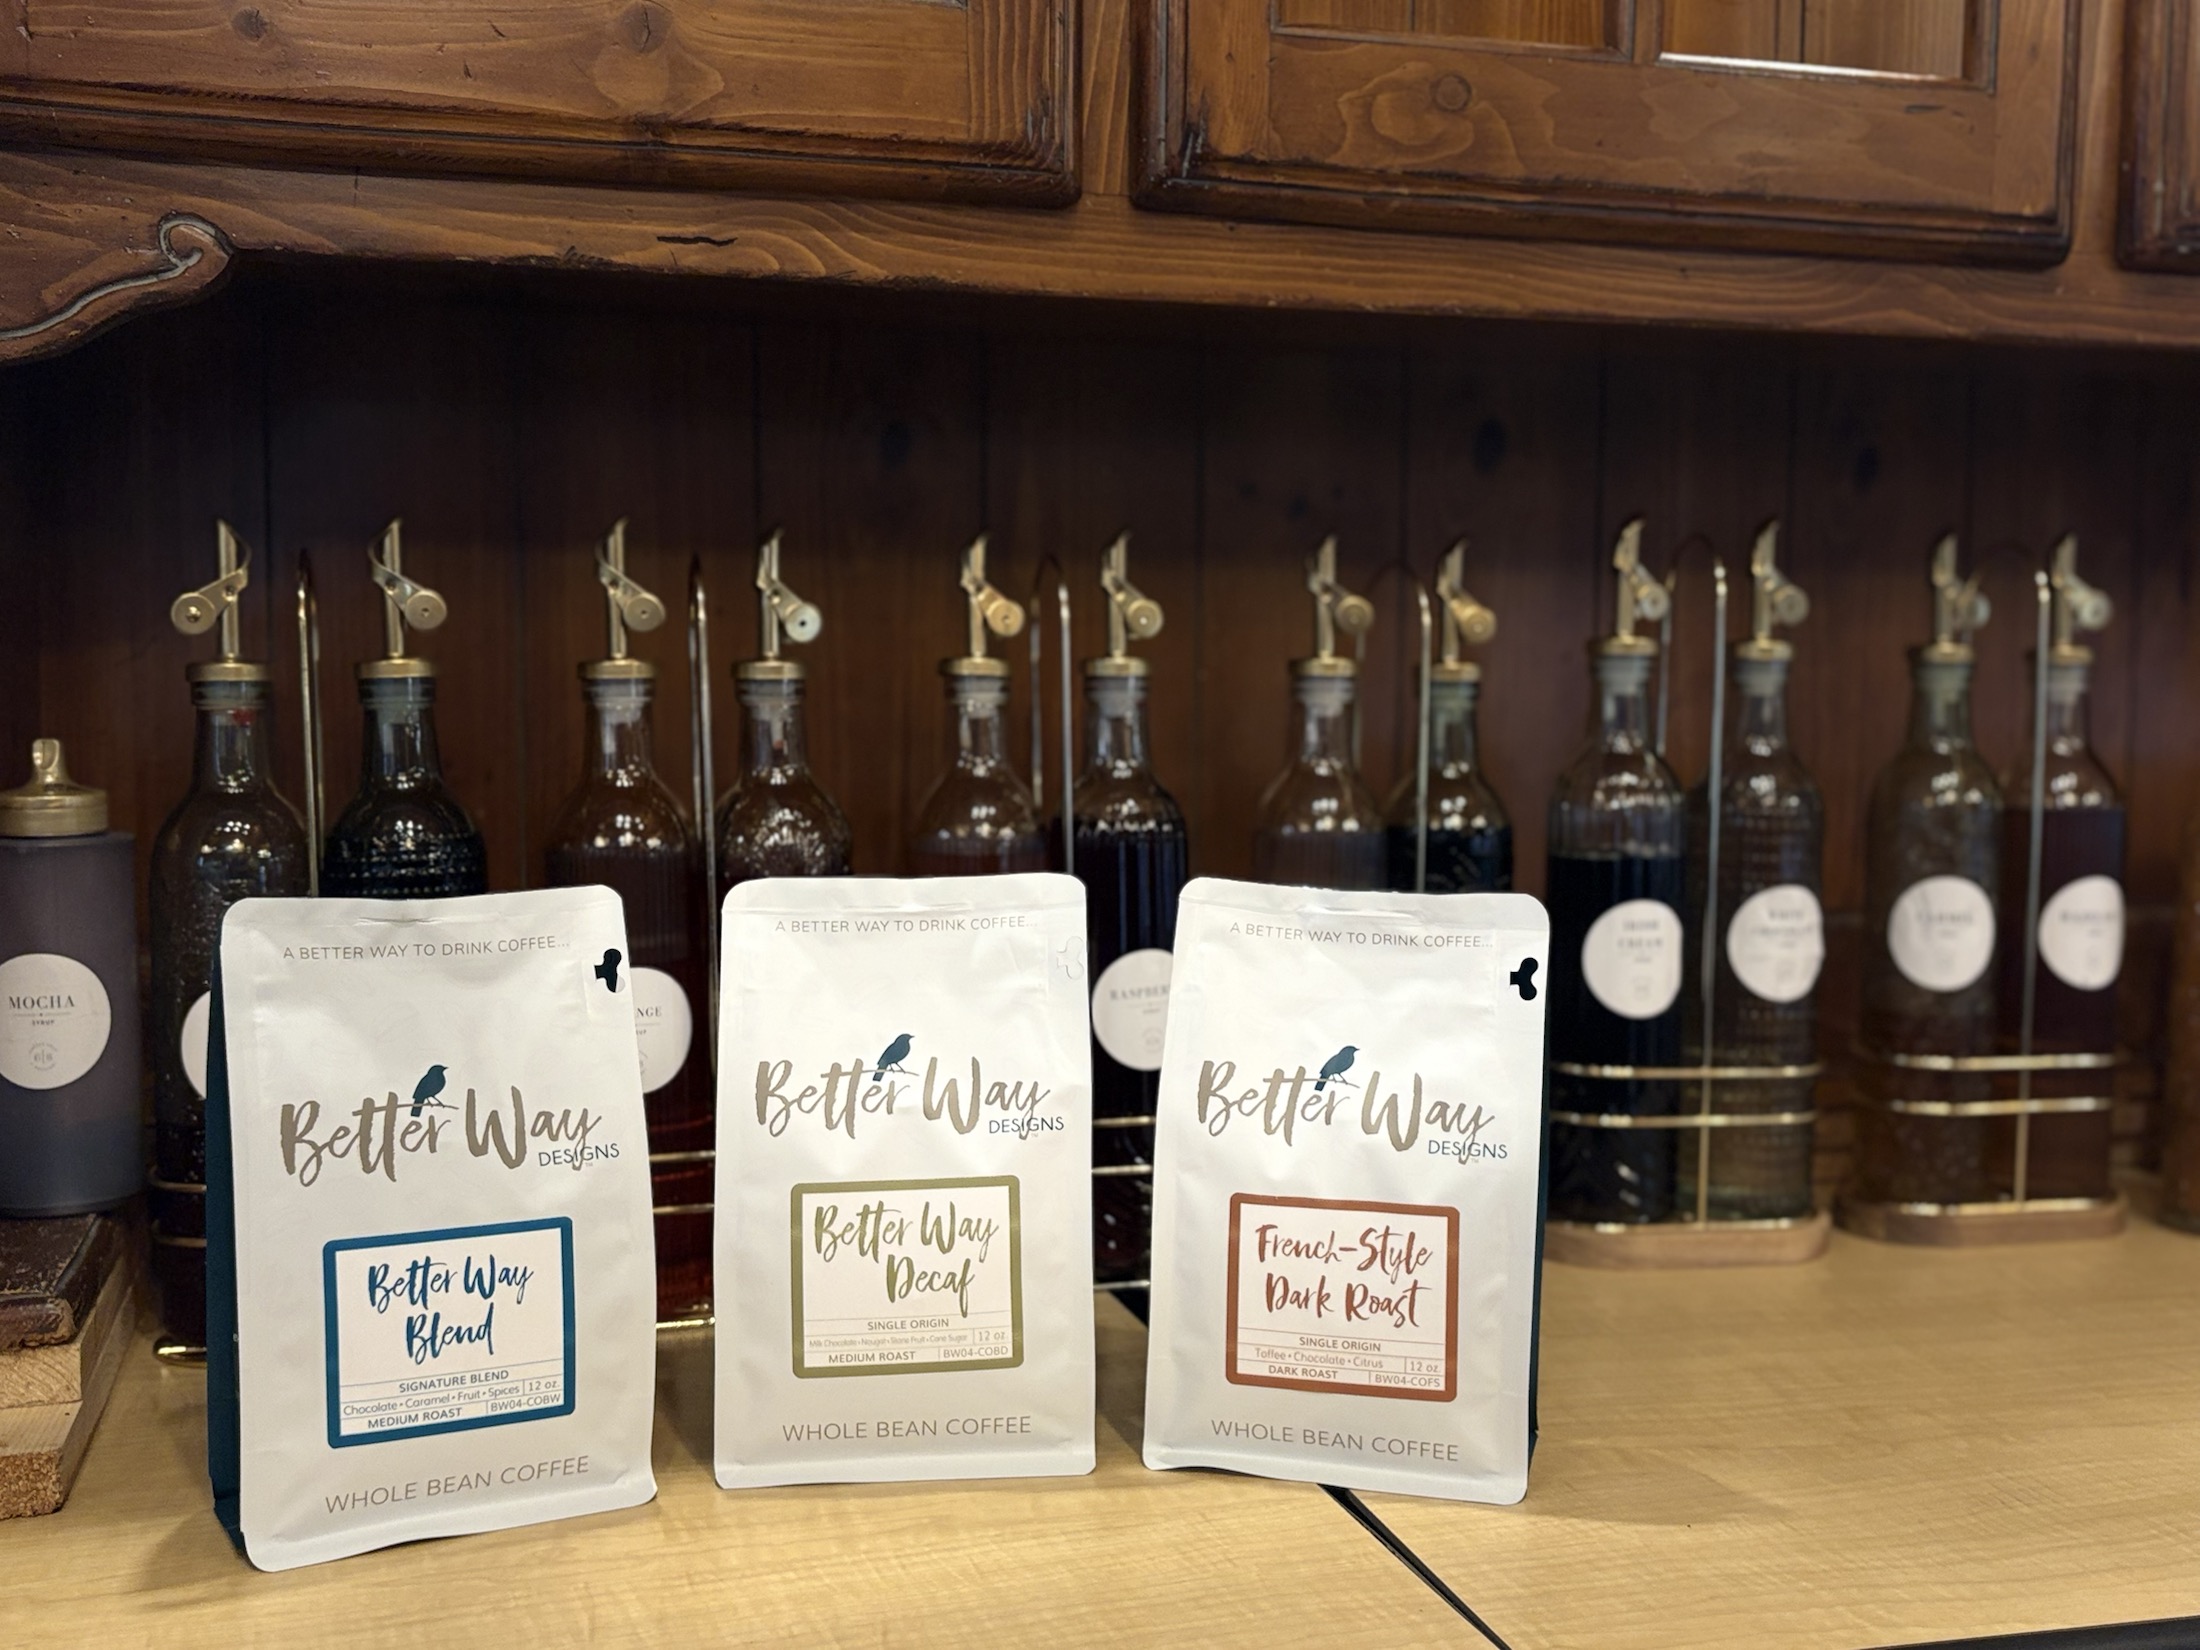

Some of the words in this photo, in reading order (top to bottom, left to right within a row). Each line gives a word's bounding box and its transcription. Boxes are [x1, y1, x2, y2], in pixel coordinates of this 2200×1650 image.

[775, 921, 786, 932] A
[791, 920, 850, 933] BETTER
[855, 920, 890, 932] WAY
[894, 919, 915, 932] TO
[919, 919, 966, 932] DRINK
[1230, 922, 1240, 934] A
[1245, 923, 1303, 941] BETTER
[1308, 930, 1342, 943] WAY
[1347, 932, 1367, 945] TO
[1372, 933, 1419, 947] DRINK
[283, 947, 294, 959] A
[299, 946, 364, 960] BETTER
[370, 944, 408, 958] WAY
[413, 943, 436, 957] TO
[442, 941, 492, 956] DRINK
[8, 995, 75, 1009] MOCHA
[636, 1006, 662, 1018] NGE
[755, 1058, 913, 1140] Better
[923, 1056, 1051, 1140] Way
[1197, 1060, 1354, 1147] Better
[1361, 1071, 1495, 1165] Way
[280, 1091, 454, 1187] Better
[465, 1085, 602, 1172] Way
[989, 1116, 1064, 1134] DESIGNS
[538, 1142, 620, 1167] DESIGNS
[1428, 1139, 1508, 1159] DESIGNS
[814, 1200, 913, 1263] Better
[920, 1201, 999, 1263] Way
[1255, 1224, 1433, 1285] French-Style
[368, 1255, 458, 1314] Better
[464, 1254, 534, 1304] Way
[886, 1254, 975, 1318] Decaf
[1265, 1273, 1334, 1318] Dark
[1345, 1279, 1432, 1328] Roast
[406, 1302, 494, 1365] Blend
[867, 1320, 907, 1331] SINGLE
[910, 1318, 950, 1329] ORIGIN
[979, 1331, 990, 1341] 12
[1299, 1337, 1339, 1350] SINGLE
[1341, 1340, 1381, 1352] ORIGIN
[828, 1353, 876, 1364] MEDIUM
[879, 1351, 916, 1362] ROAST
[1255, 1347, 1286, 1360] Toffee
[1293, 1351, 1345, 1367] Chocolate
[1353, 1357, 1384, 1369] Citrus
[1410, 1361, 1424, 1373] 12
[399, 1376, 466, 1393] SIGNATURE
[470, 1370, 509, 1384] BLEND
[1268, 1365, 1299, 1377] DARK
[1301, 1368, 1339, 1380] ROAST
[528, 1381, 541, 1393] 12
[343, 1401, 398, 1416] Chocolate
[405, 1394, 450, 1409] Caramel
[457, 1390, 481, 1401] Fruit
[488, 1384, 520, 1400] Spices
[367, 1414, 419, 1429] MEDIUM
[423, 1408, 463, 1422] ROAST
[783, 1422, 868, 1441] WHOLE
[876, 1420, 938, 1438] BEAN
[946, 1416, 1032, 1435] COFFEE
[1211, 1419, 1294, 1442] WHOLE
[1303, 1429, 1363, 1450] BEAN
[1372, 1436, 1459, 1462] COFFEE
[325, 1482, 418, 1514] WHOLE
[427, 1471, 492, 1496] BEAN
[501, 1455, 590, 1484] COFFEE
